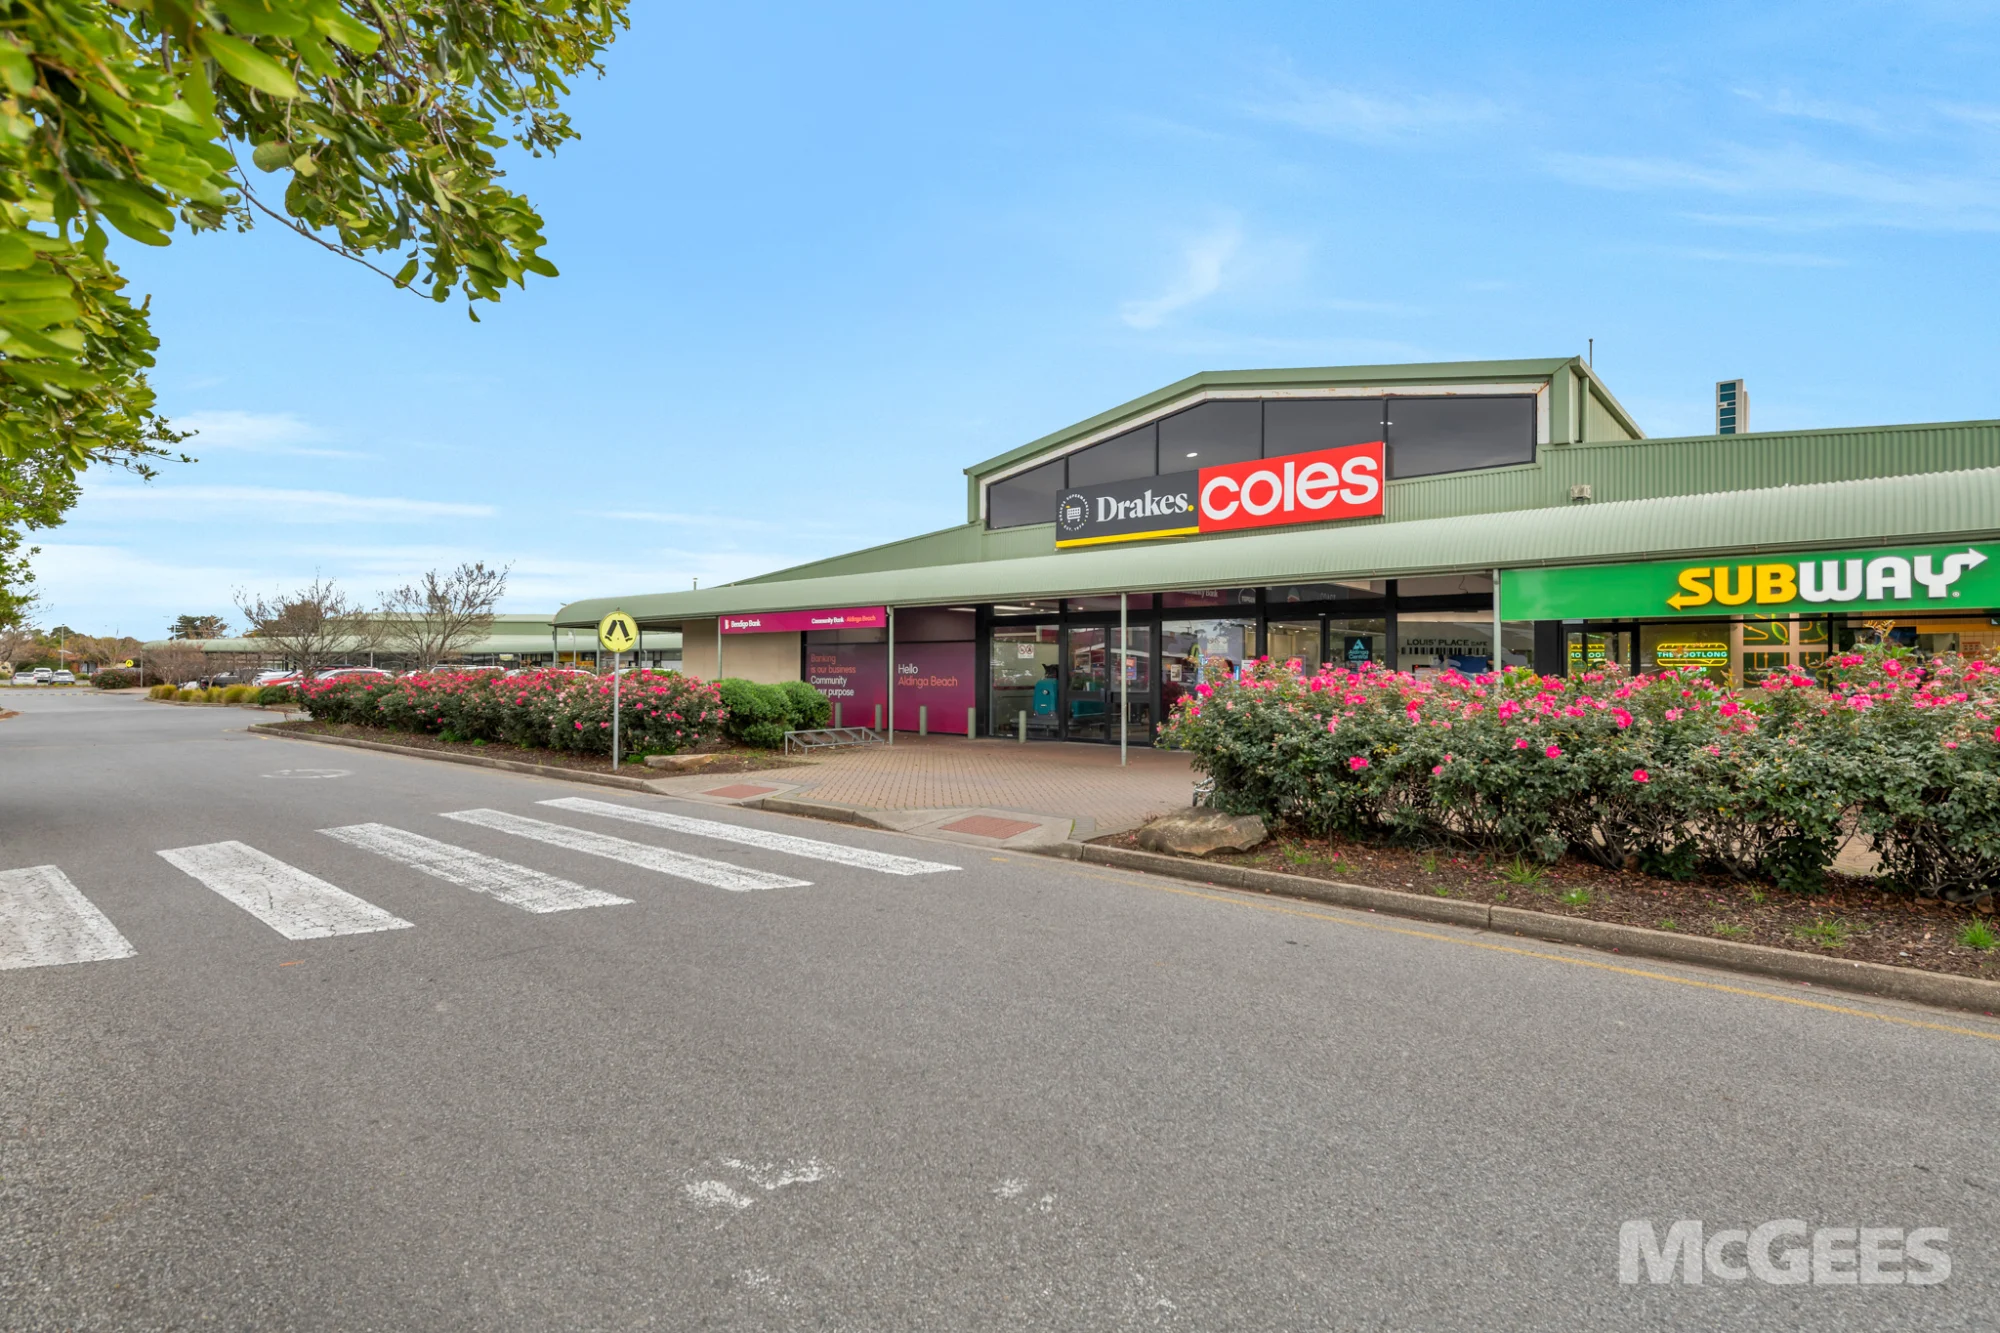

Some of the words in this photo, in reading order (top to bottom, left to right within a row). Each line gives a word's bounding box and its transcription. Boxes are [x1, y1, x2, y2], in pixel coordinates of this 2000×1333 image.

[1200, 456, 1379, 521] coles
[1666, 547, 1988, 611] SUBWAY
[748, 618, 762, 627] Bank
[811, 617, 834, 625] Community
[833, 616, 845, 624] Bank
[861, 614, 877, 622] Beach
[1438, 638, 1469, 647] PLACE
[810, 653, 837, 665] Banking
[810, 664, 816, 674] is
[817, 666, 827, 674] our
[828, 664, 857, 674] business
[897, 663, 919, 674] Hello
[810, 675, 848, 688] Community
[897, 676, 929, 689] Aldinga
[930, 675, 958, 687] Beach
[828, 688, 855, 699] purpose
